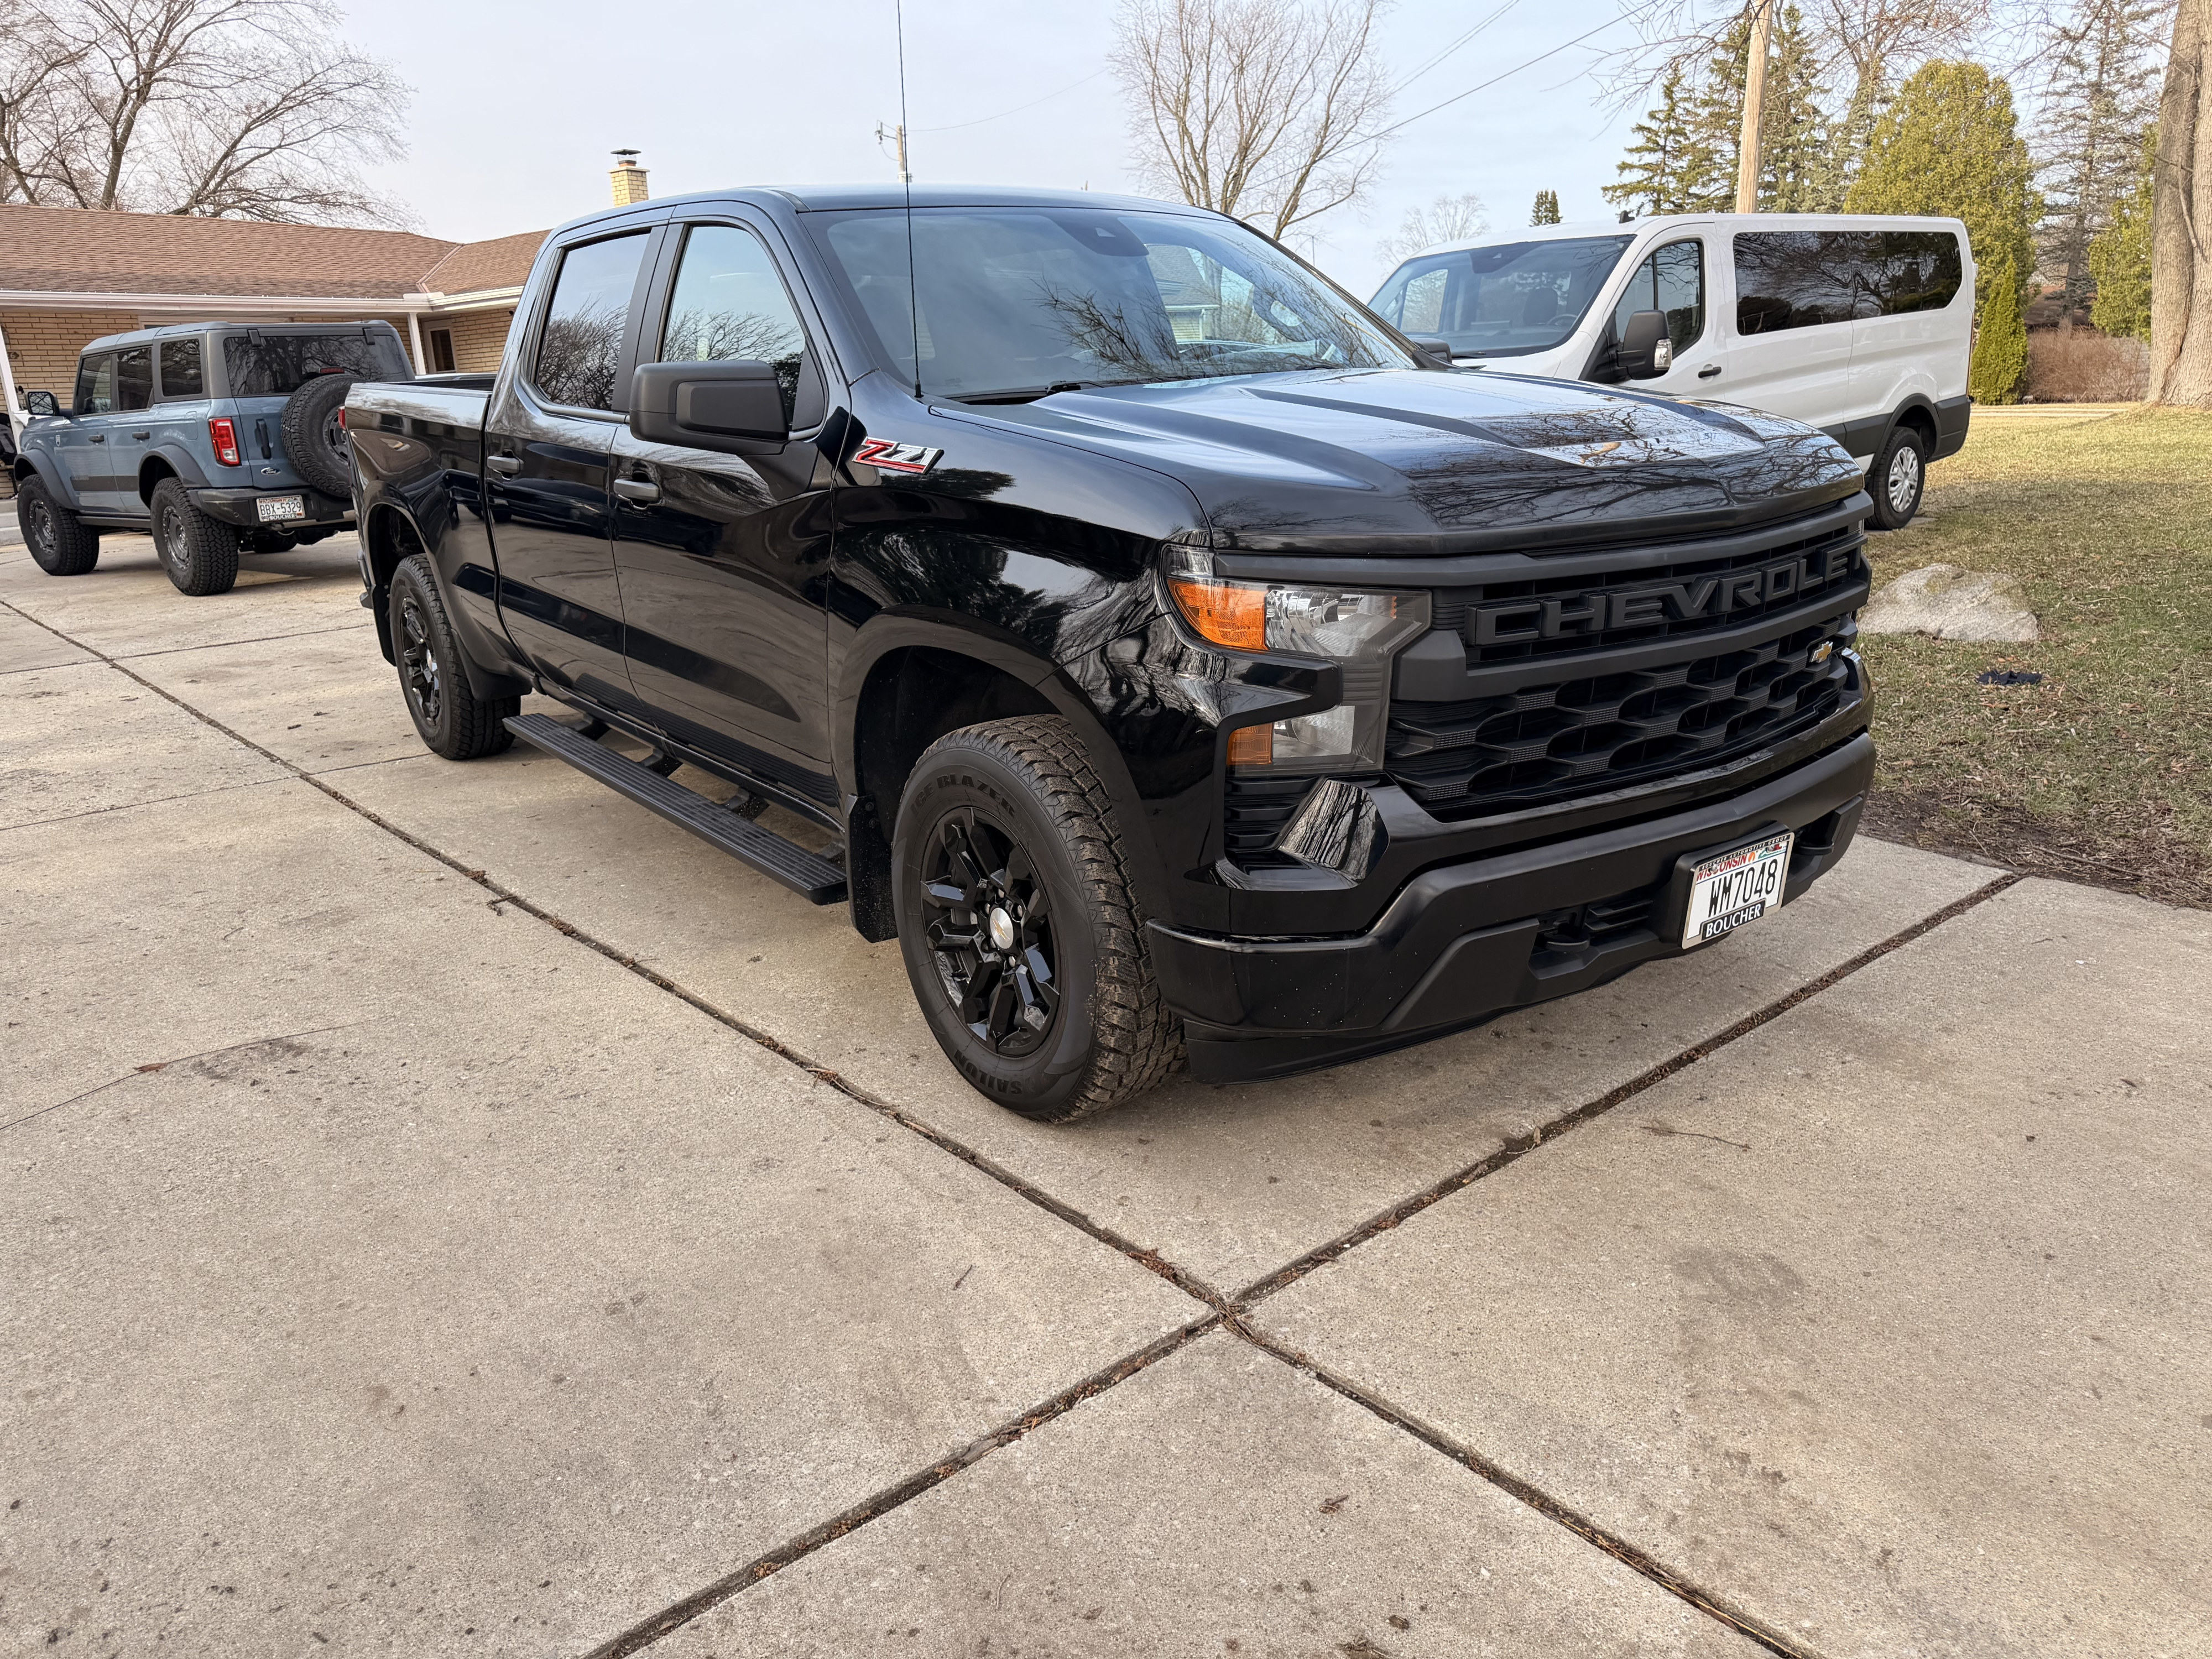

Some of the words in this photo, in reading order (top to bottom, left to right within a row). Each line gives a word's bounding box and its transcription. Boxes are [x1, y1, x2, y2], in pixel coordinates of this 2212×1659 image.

[852, 436, 945, 476] Z71
[259, 501, 301, 515] BBX-5329
[1466, 535, 1868, 646] CHEVROLET
[910, 782, 935, 818] ICE
[937, 774, 1015, 818] BLAZER
[1702, 857, 1727, 870] BOUCHER
[1729, 842, 1766, 859] AUTOMOTIVE
[1768, 836, 1787, 845] GROUP
[1708, 859, 1778, 918] WM7048
[1705, 903, 1762, 938] BOUCHER
[954, 1050, 1022, 1095] SAILUN
